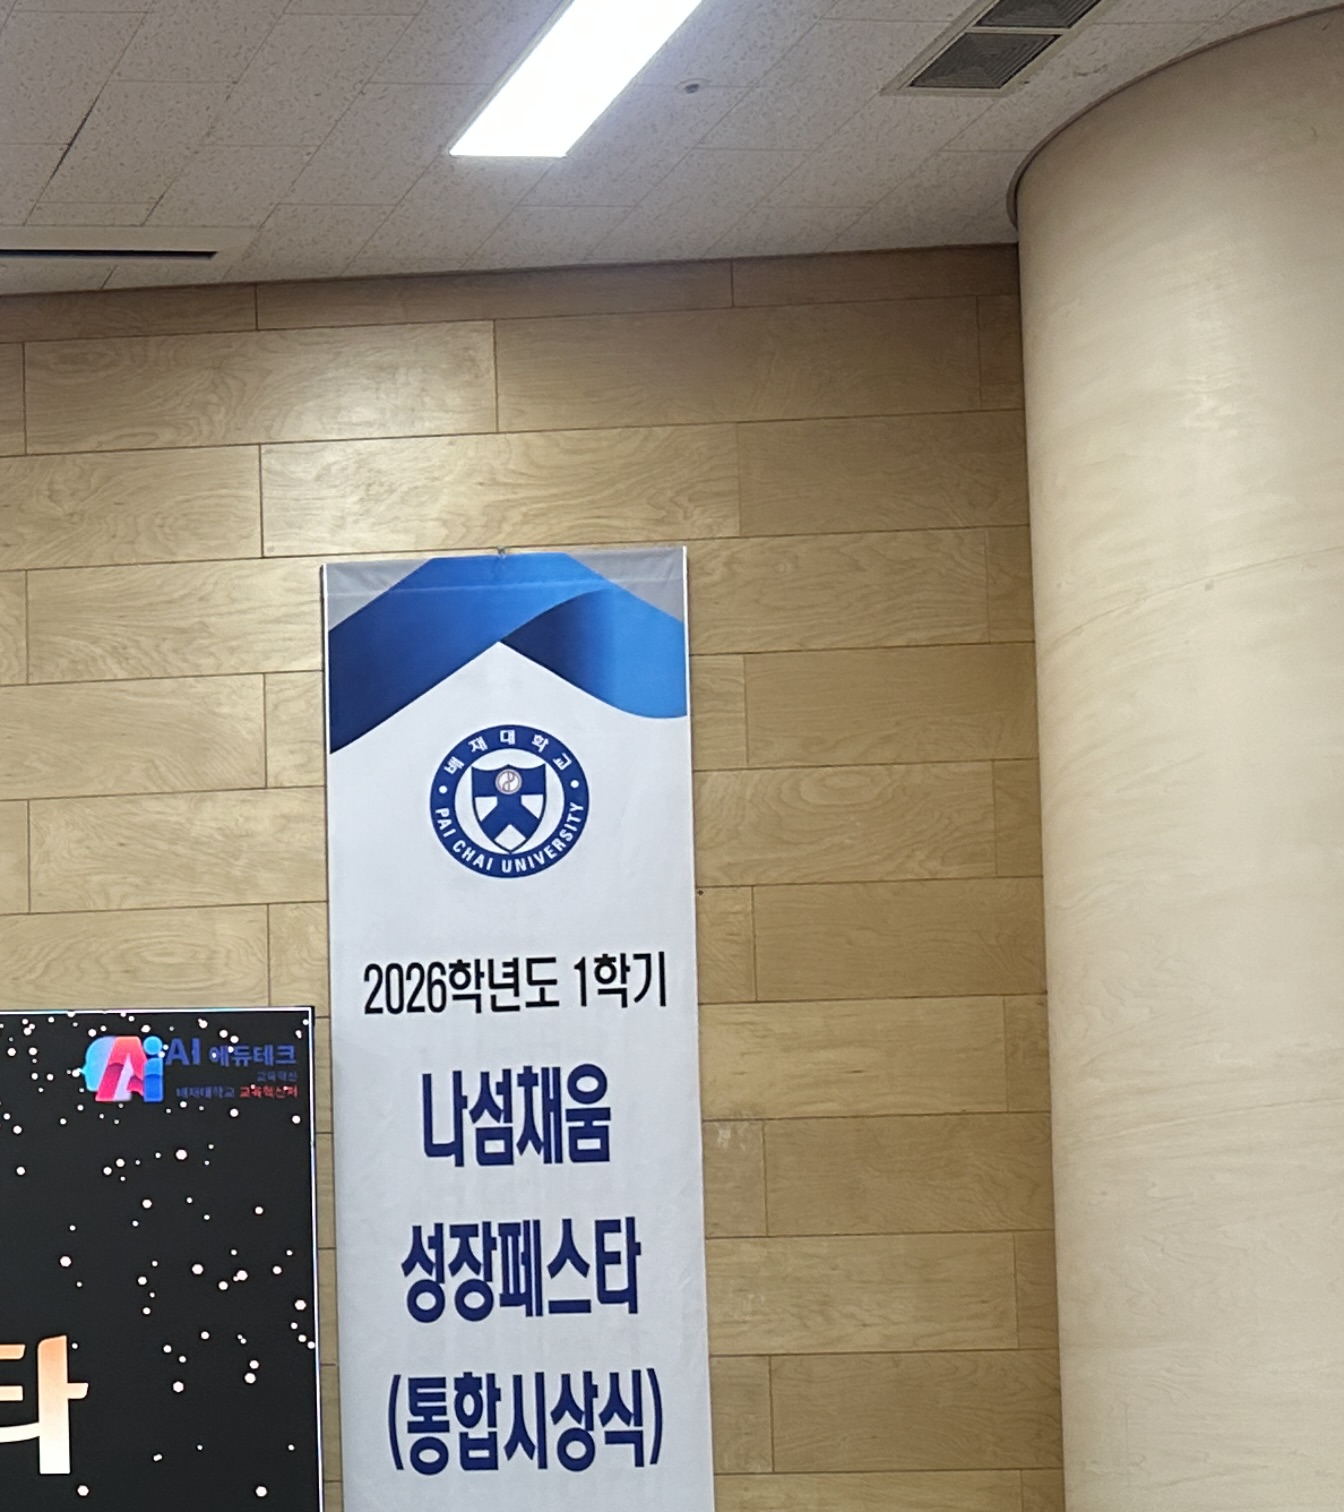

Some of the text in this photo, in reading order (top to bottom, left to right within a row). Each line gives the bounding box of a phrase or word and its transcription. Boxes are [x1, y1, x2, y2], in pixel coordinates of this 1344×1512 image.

[443, 729, 572, 775] 배재대학교
[435, 802, 585, 873] PAI CHAI UNIVERSITY
[363, 951, 667, 1015] 2026학년도 1학기
[165, 1037, 297, 1067] AI 에듀테크
[422, 1063, 612, 1168] 나섬채움
[400, 1216, 642, 1324] 성장페스타
[388, 1367, 663, 1476] (통합시상식)
